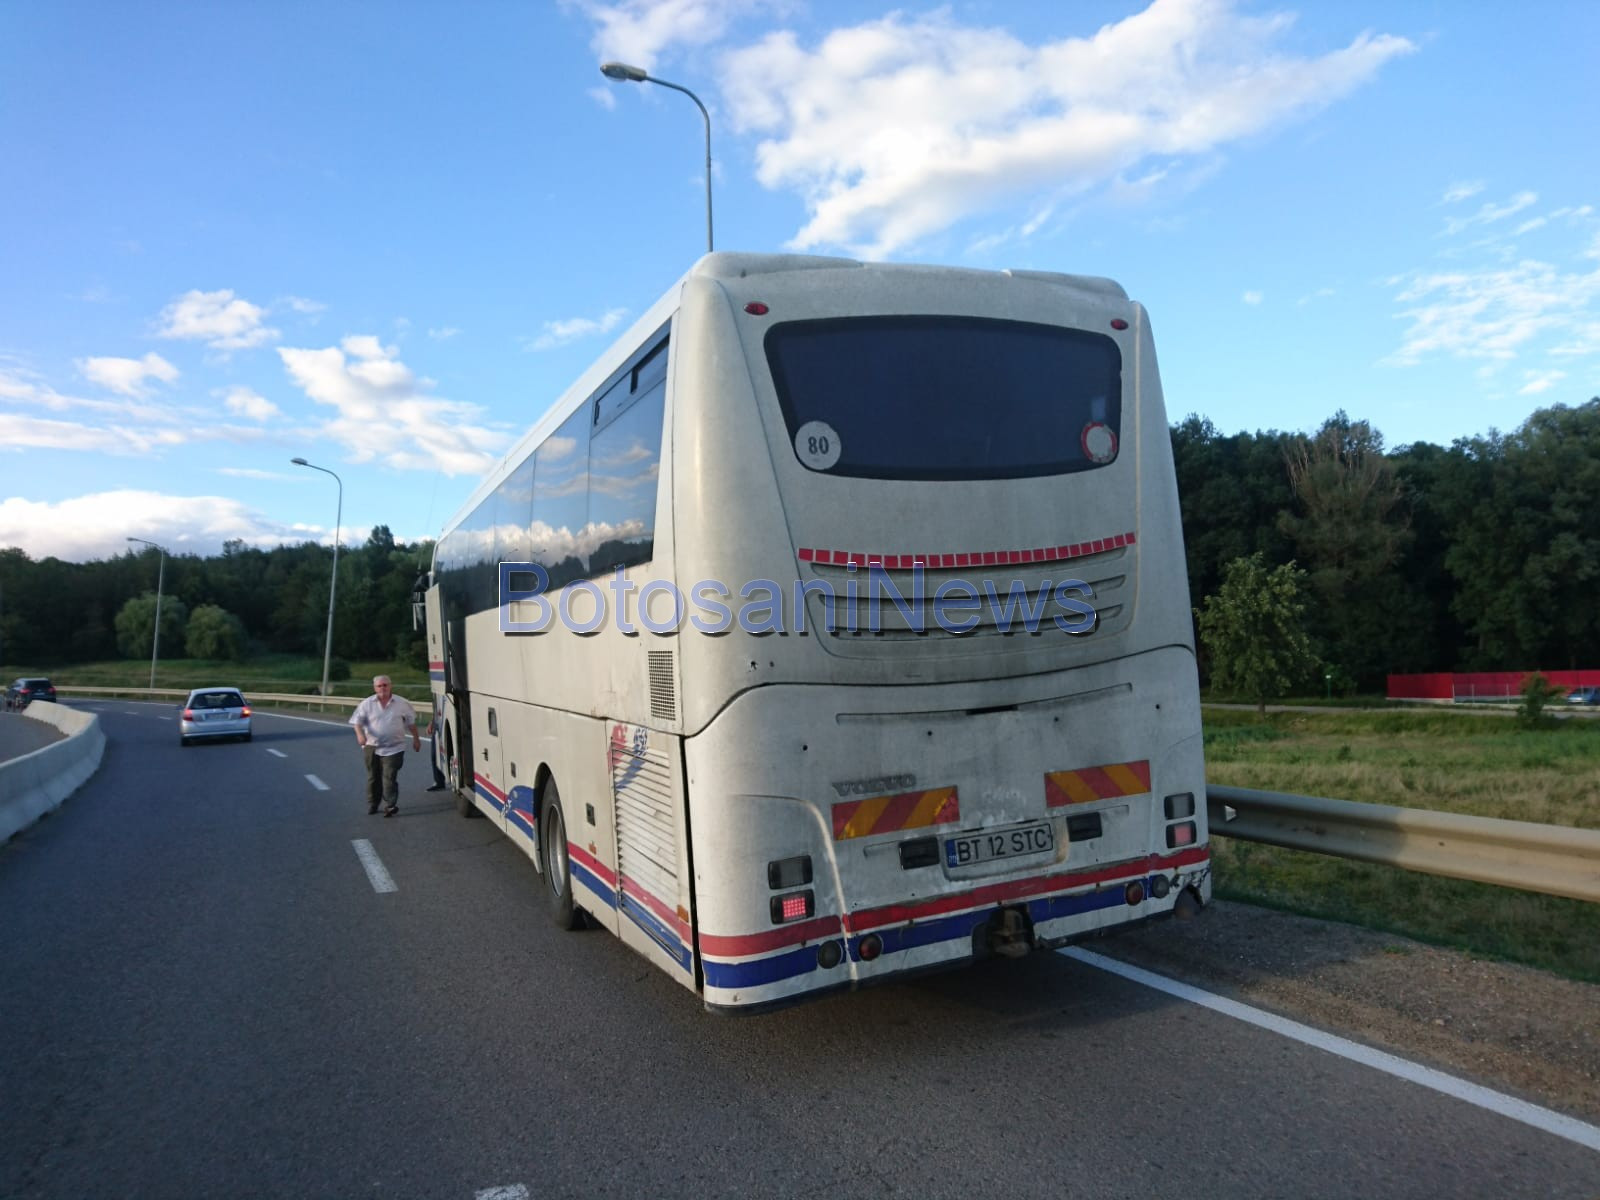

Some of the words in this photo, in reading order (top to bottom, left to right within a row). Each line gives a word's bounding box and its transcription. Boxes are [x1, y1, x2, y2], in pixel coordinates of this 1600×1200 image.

[808, 436, 829, 455] 80
[957, 839, 981, 862] BT
[988, 836, 1006, 857] 12
[1011, 829, 1047, 852] STC
